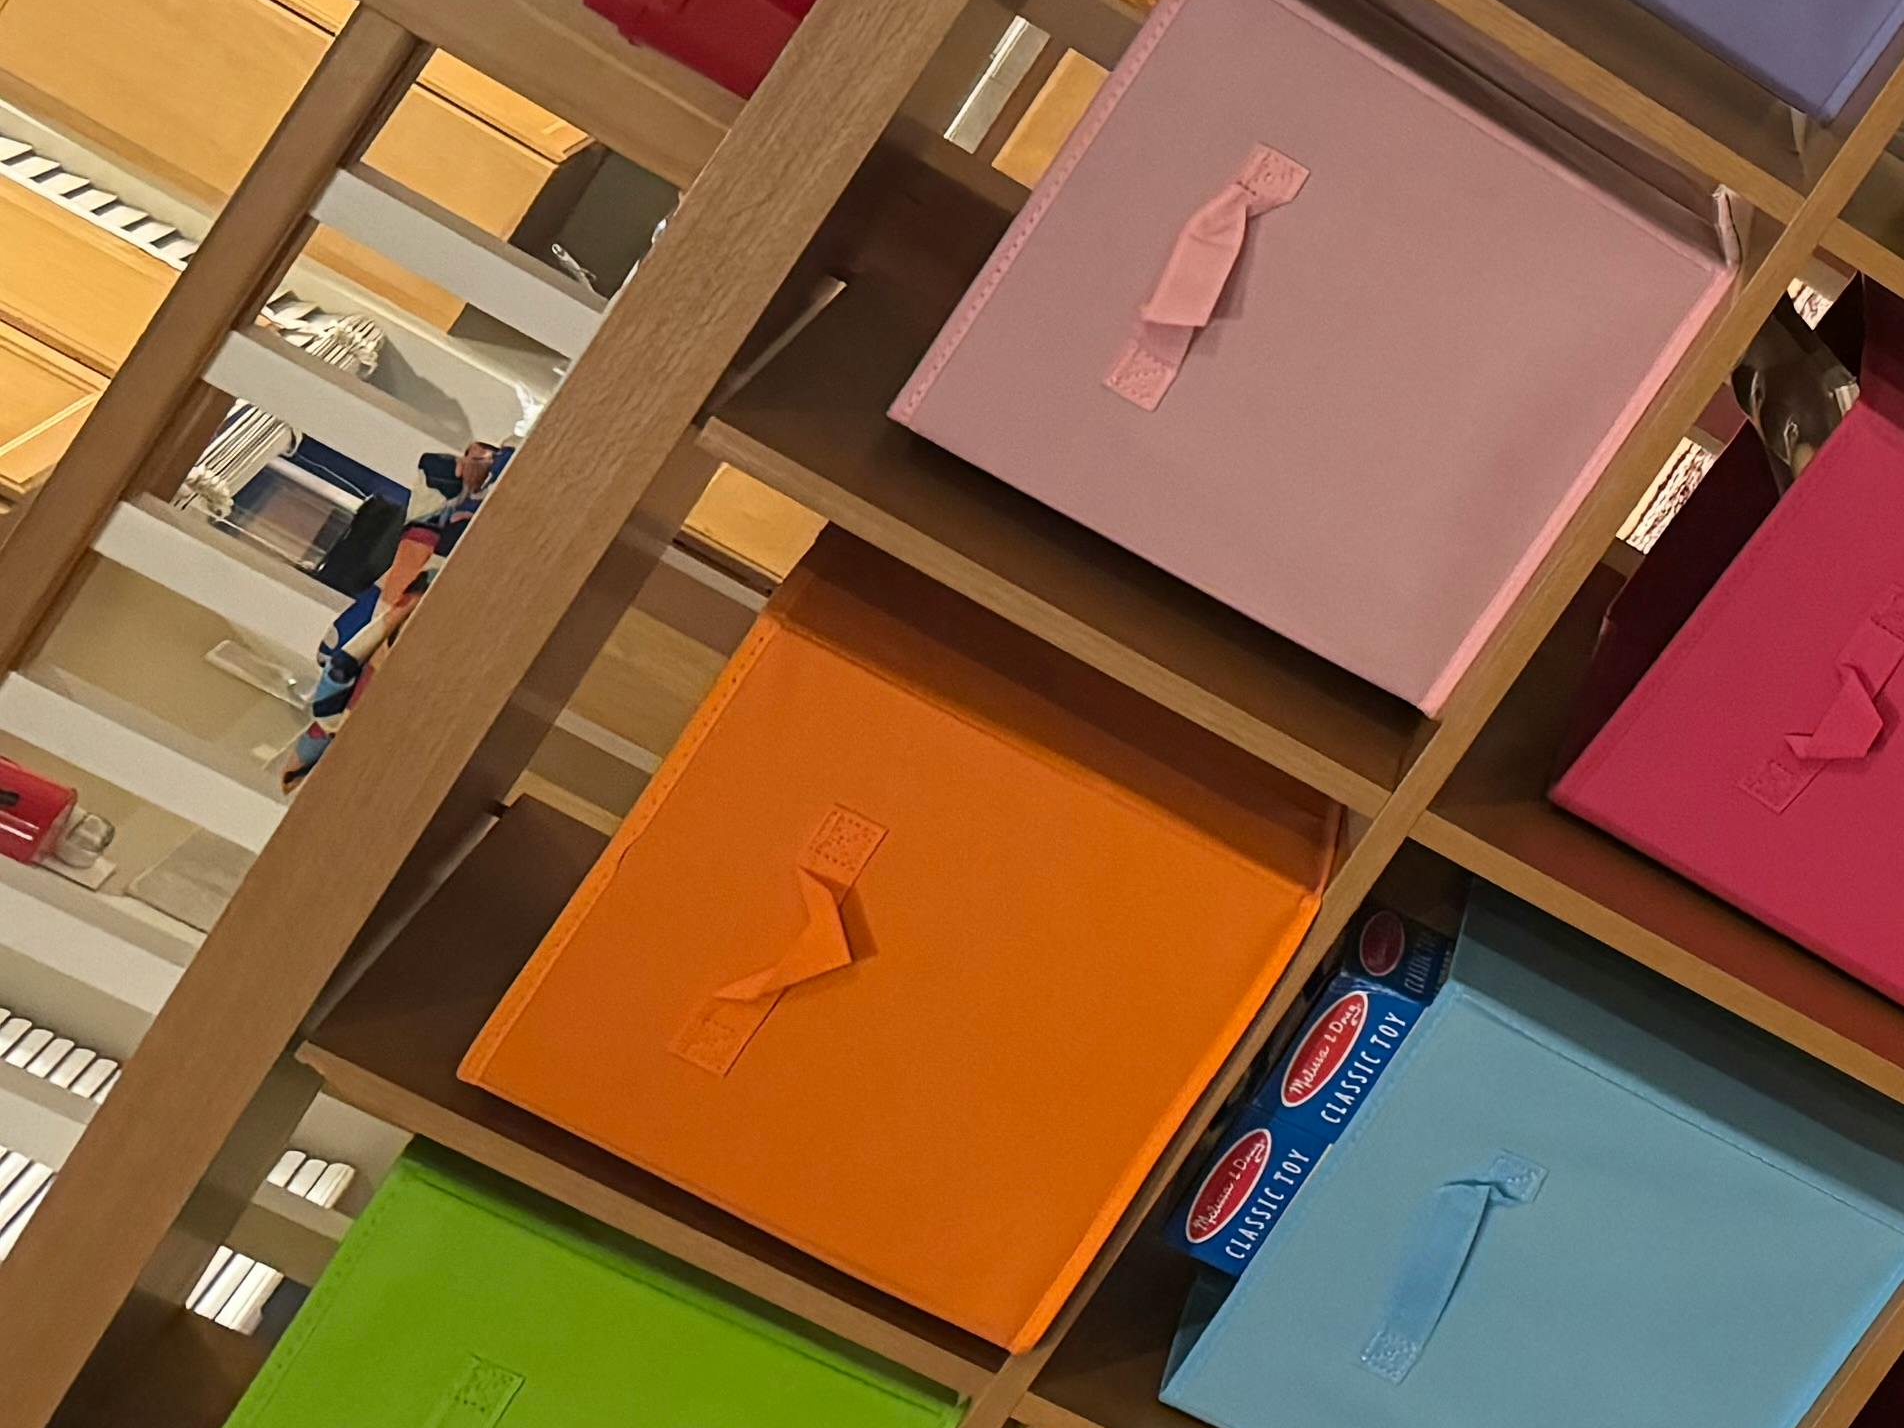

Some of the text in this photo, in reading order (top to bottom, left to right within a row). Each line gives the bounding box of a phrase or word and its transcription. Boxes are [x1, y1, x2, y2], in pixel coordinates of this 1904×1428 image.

[1288, 1045, 1330, 1095] Melissa
[1320, 1051, 1381, 1124] CLASSIC
[1369, 1011, 1406, 1049] TOY
[1192, 1182, 1235, 1232] Melissa
[1225, 1148, 1310, 1260] CLASSIC TOY
